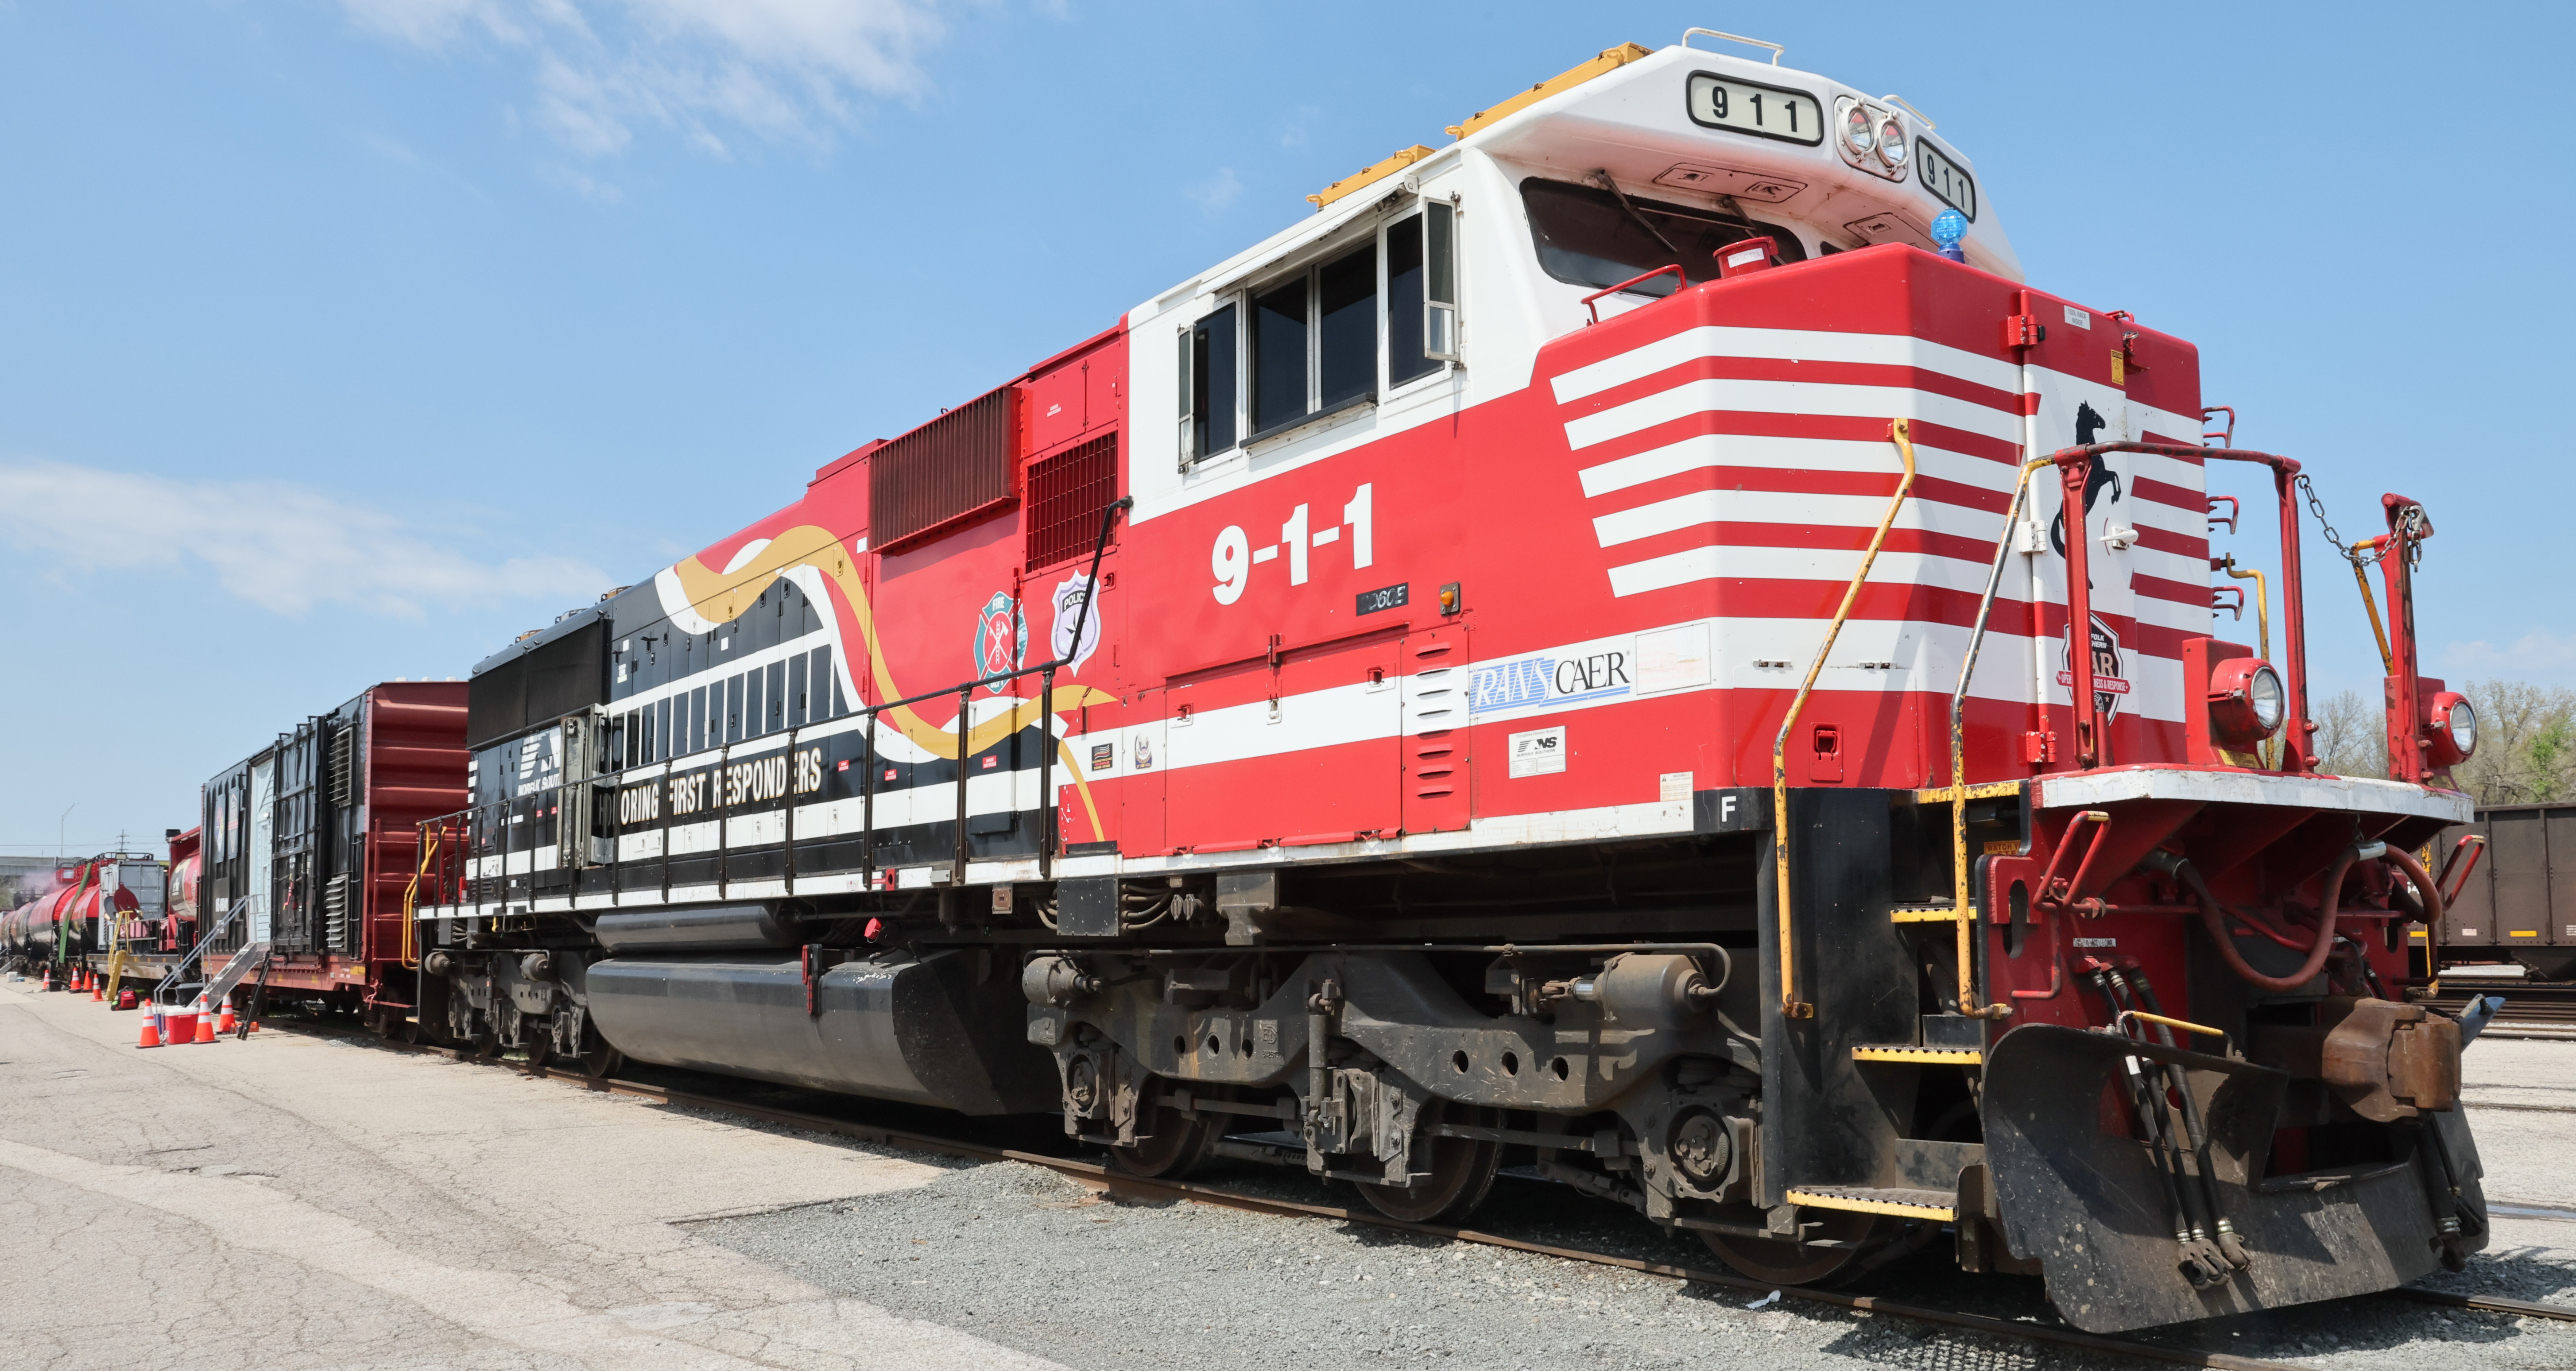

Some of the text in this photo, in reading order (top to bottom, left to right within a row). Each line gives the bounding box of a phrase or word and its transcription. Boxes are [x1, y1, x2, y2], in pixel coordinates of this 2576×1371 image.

[1712, 86, 1797, 132] 911
[1927, 154, 1964, 209] 911
[1732, 254, 1748, 263] SAND
[2068, 308, 2076, 317] TOOL
[2072, 318, 2083, 326] INSIDE
[1212, 482, 1372, 605] 9-1-1
[992, 596, 1005, 612] FIRE
[2092, 640, 2107, 649] HERN
[2092, 651, 2115, 678] AR
[2107, 680, 2126, 692] RESPONSE
[1722, 796, 1736, 821] F
[1987, 843, 2012, 851] WATCH
